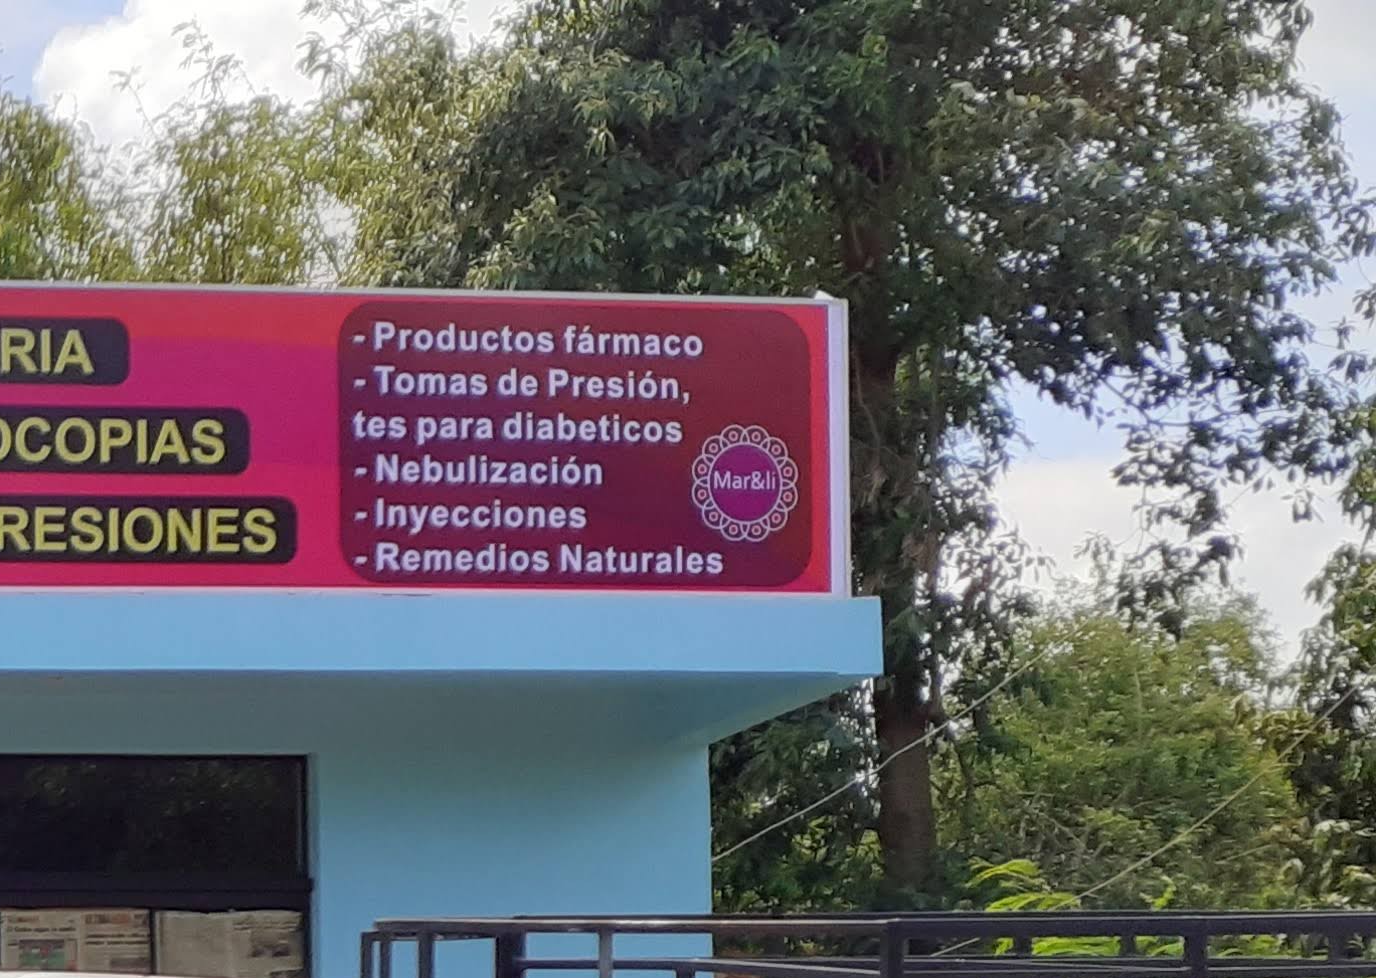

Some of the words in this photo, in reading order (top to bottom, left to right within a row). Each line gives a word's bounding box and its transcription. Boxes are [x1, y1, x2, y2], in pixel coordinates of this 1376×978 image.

[373, 321, 554, 353] Productos
[564, 325, 704, 357] fármaco
[374, 366, 488, 396] Tomas
[497, 370, 538, 397] de
[549, 369, 691, 405] Presión,
[353, 411, 407, 439] tes
[417, 416, 494, 446] para
[503, 415, 683, 443] diabeticos
[375, 454, 603, 486] Nebulización
[713, 472, 777, 491] Mar&li
[375, 499, 587, 533] Inyecciones
[375, 543, 550, 572] Remedios
[560, 544, 724, 575] Naturales
